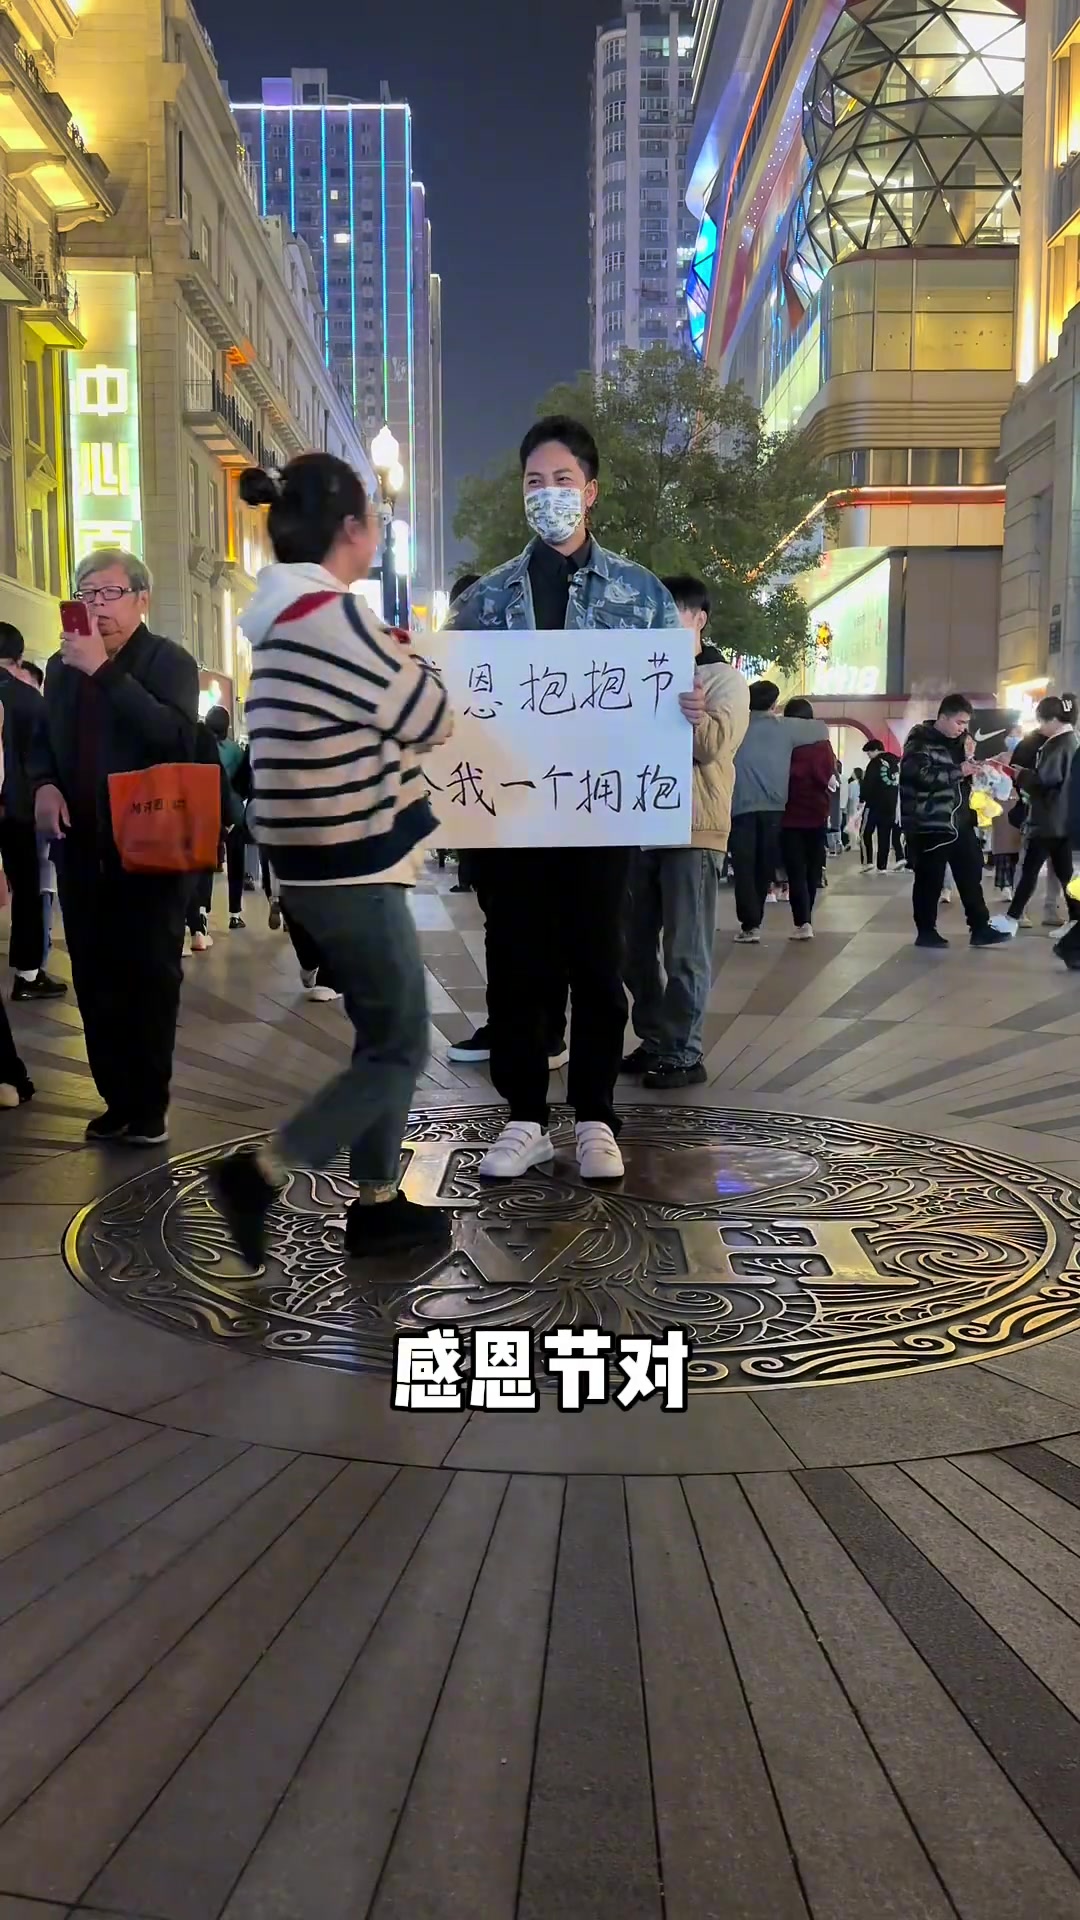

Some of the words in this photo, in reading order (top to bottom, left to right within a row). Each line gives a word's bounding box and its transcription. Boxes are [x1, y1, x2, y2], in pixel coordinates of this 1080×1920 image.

[428, 652, 674, 719] 恩抱抱节
[423, 761, 681, 816] 我一个拥抱
